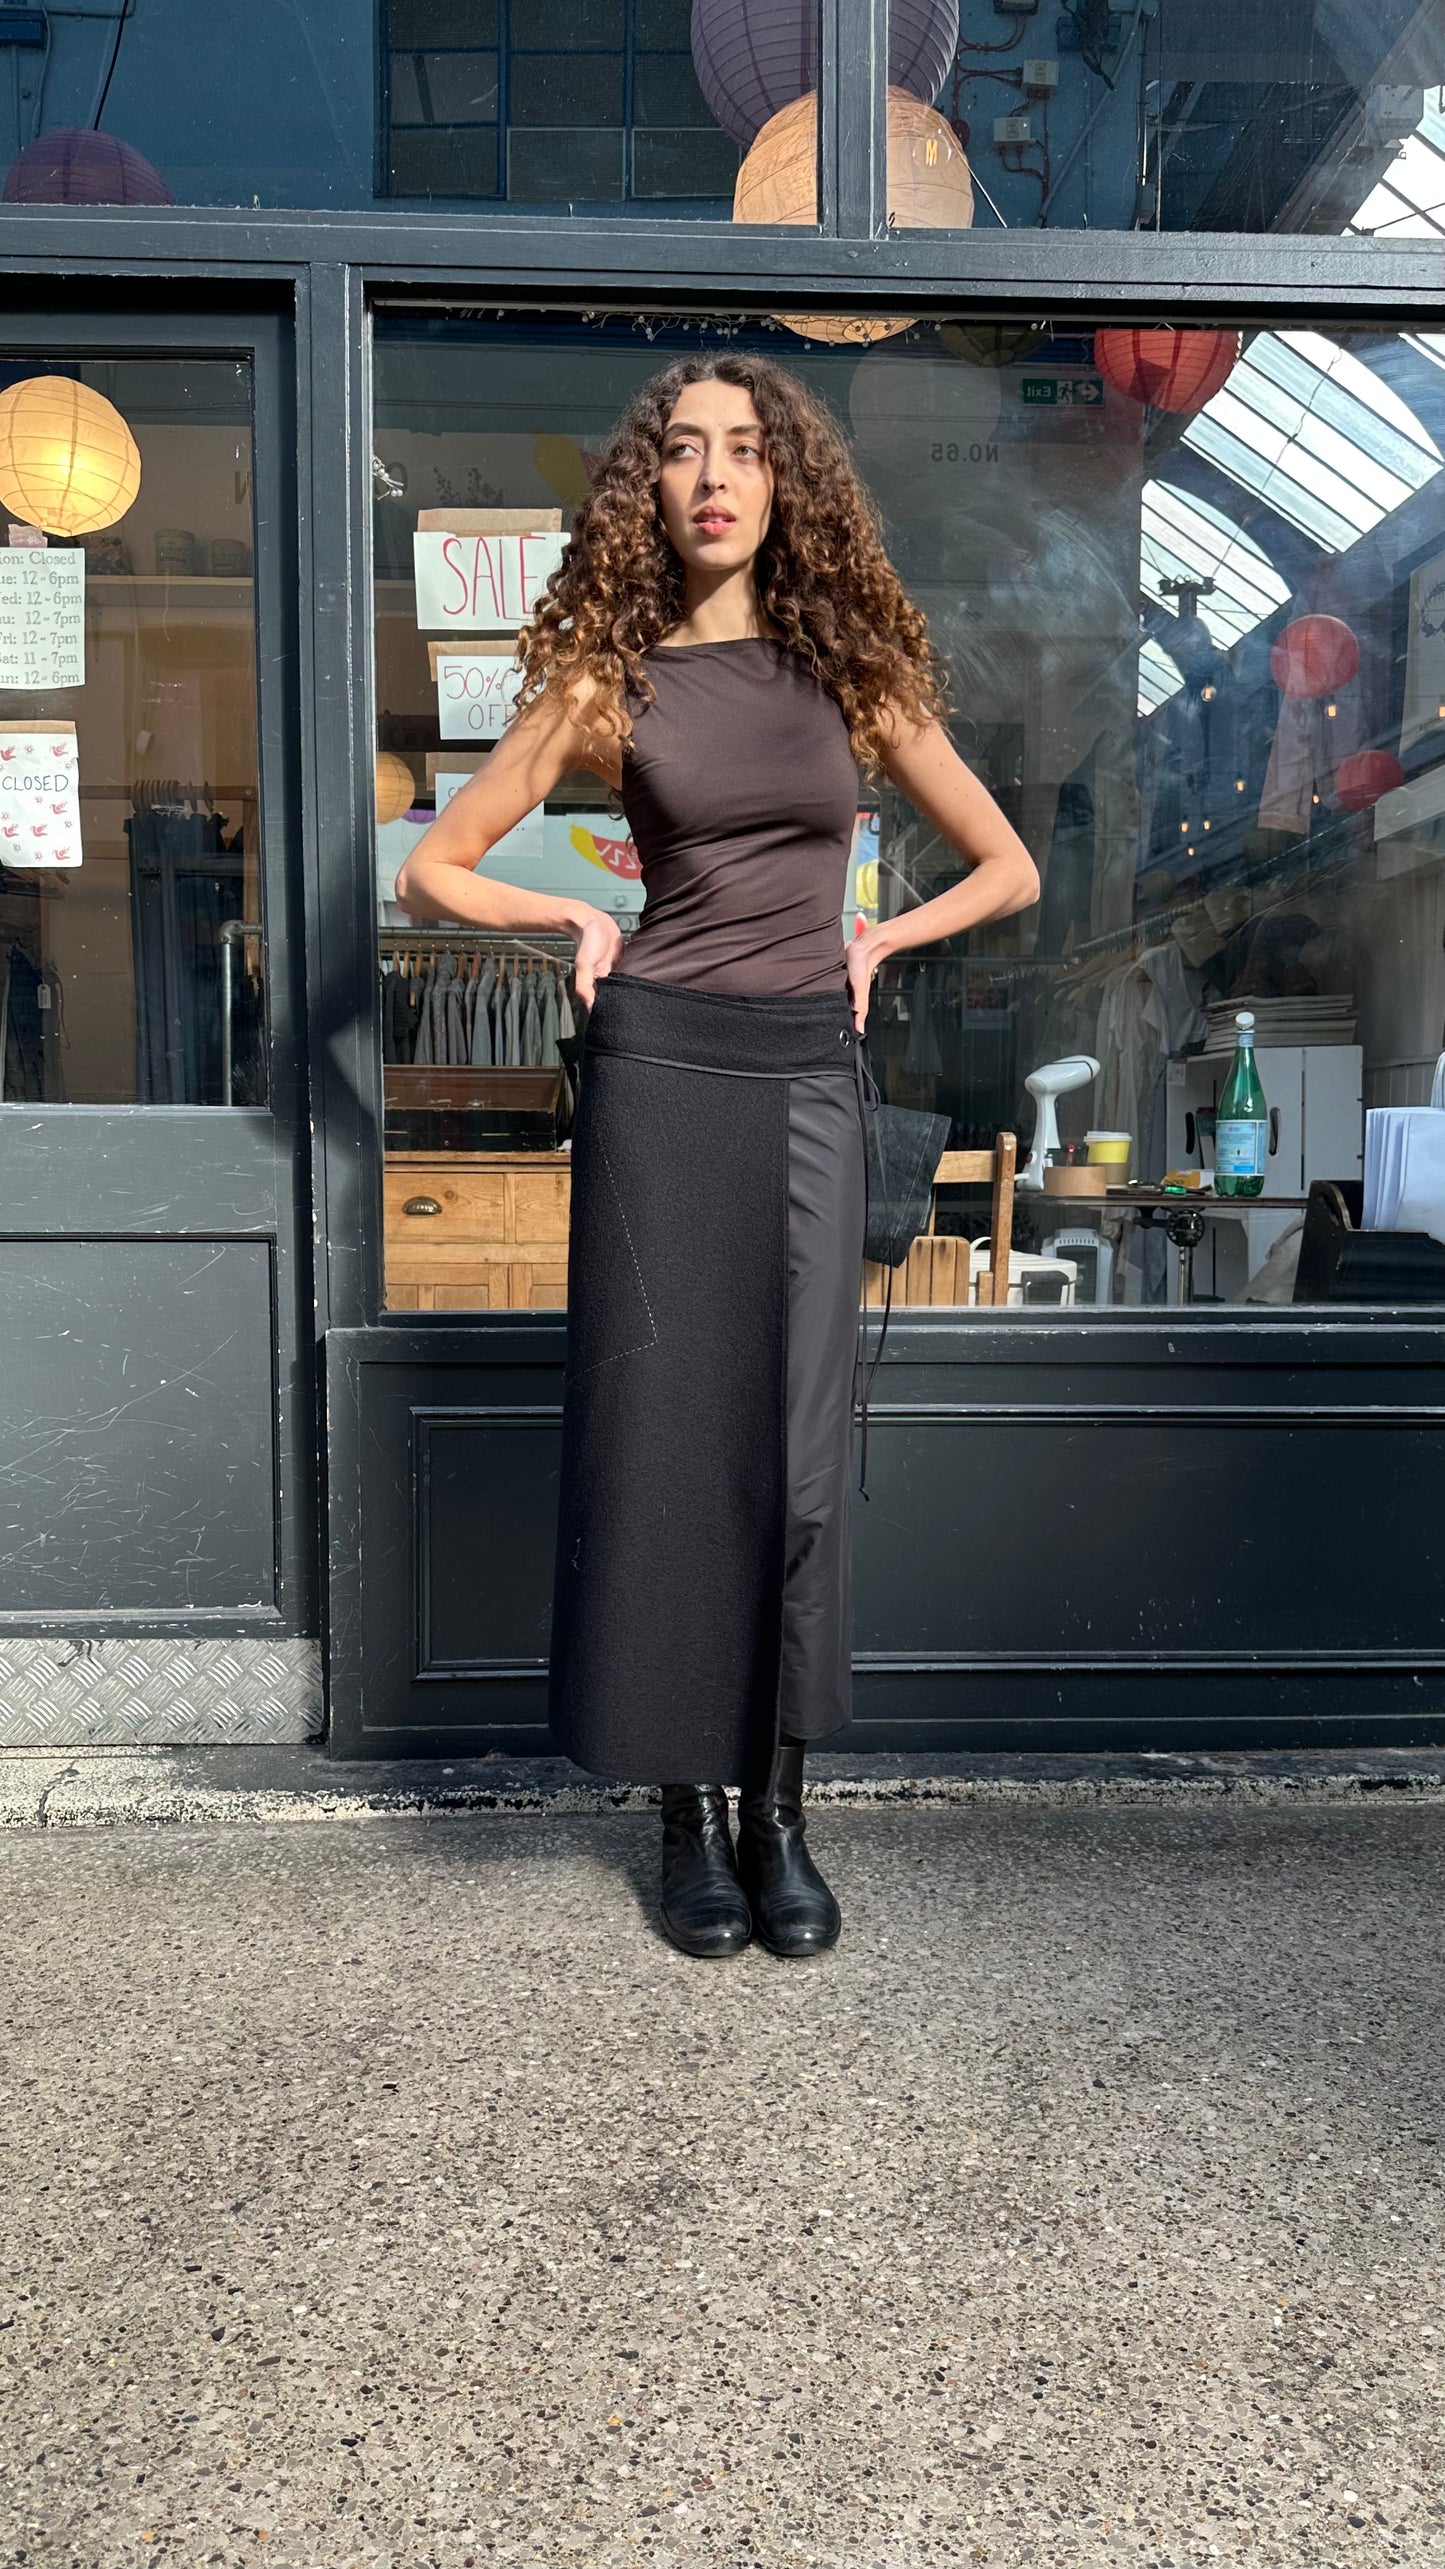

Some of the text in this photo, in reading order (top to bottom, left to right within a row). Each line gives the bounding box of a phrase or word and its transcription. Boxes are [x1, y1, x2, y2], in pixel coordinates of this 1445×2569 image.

[0, 550, 76, 565] on: Closed
[49, 571, 80, 589] 6pm
[442, 536, 546, 621] SALE
[0, 591, 22, 605] ed:
[53, 591, 82, 609] 6pm
[53, 611, 81, 628] 7pm
[50, 631, 78, 648] 7pm
[51, 651, 78, 668] 7pm
[51, 670, 80, 687] 6pm
[443, 665, 502, 700] 50%
[468, 703, 515, 730] OFF
[2, 774, 69, 793] CLOSED
